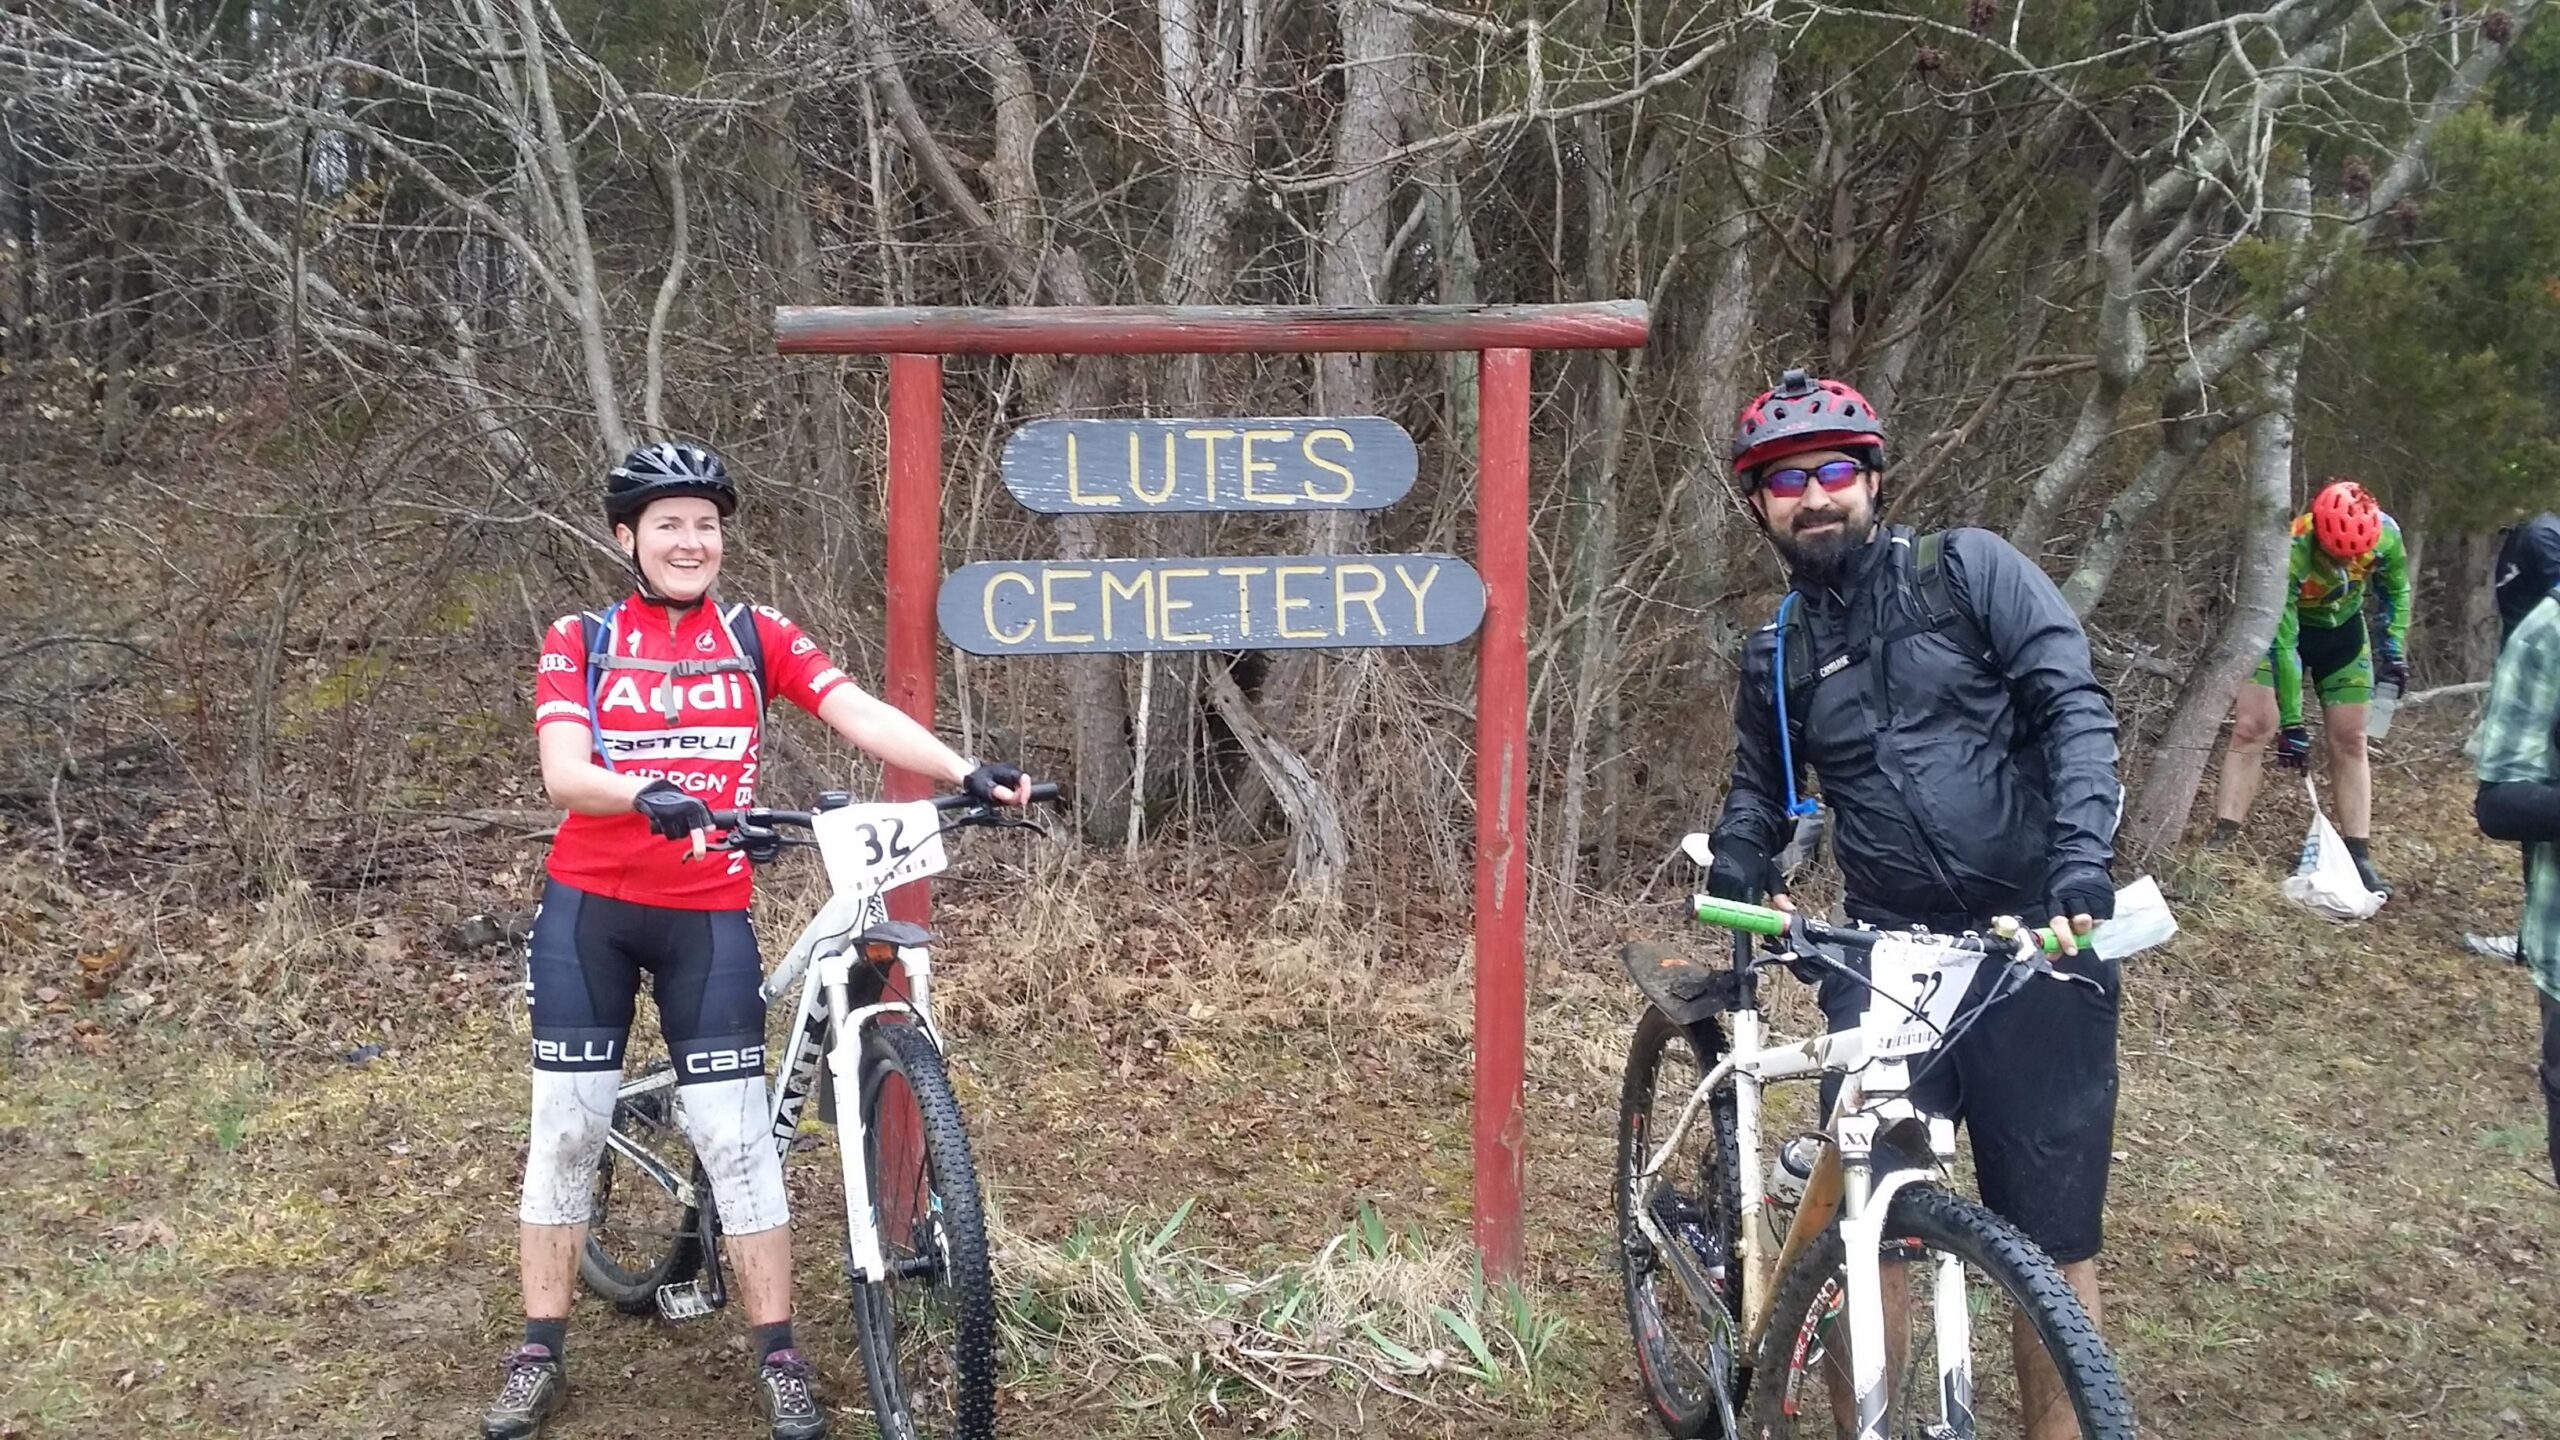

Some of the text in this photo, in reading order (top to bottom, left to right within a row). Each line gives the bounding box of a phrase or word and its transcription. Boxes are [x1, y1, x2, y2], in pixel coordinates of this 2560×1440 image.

[1067, 429, 1355, 504] LUTES
[983, 564, 1439, 645] CEMETERY
[602, 674, 742, 714] Audi
[855, 817, 911, 867] 32
